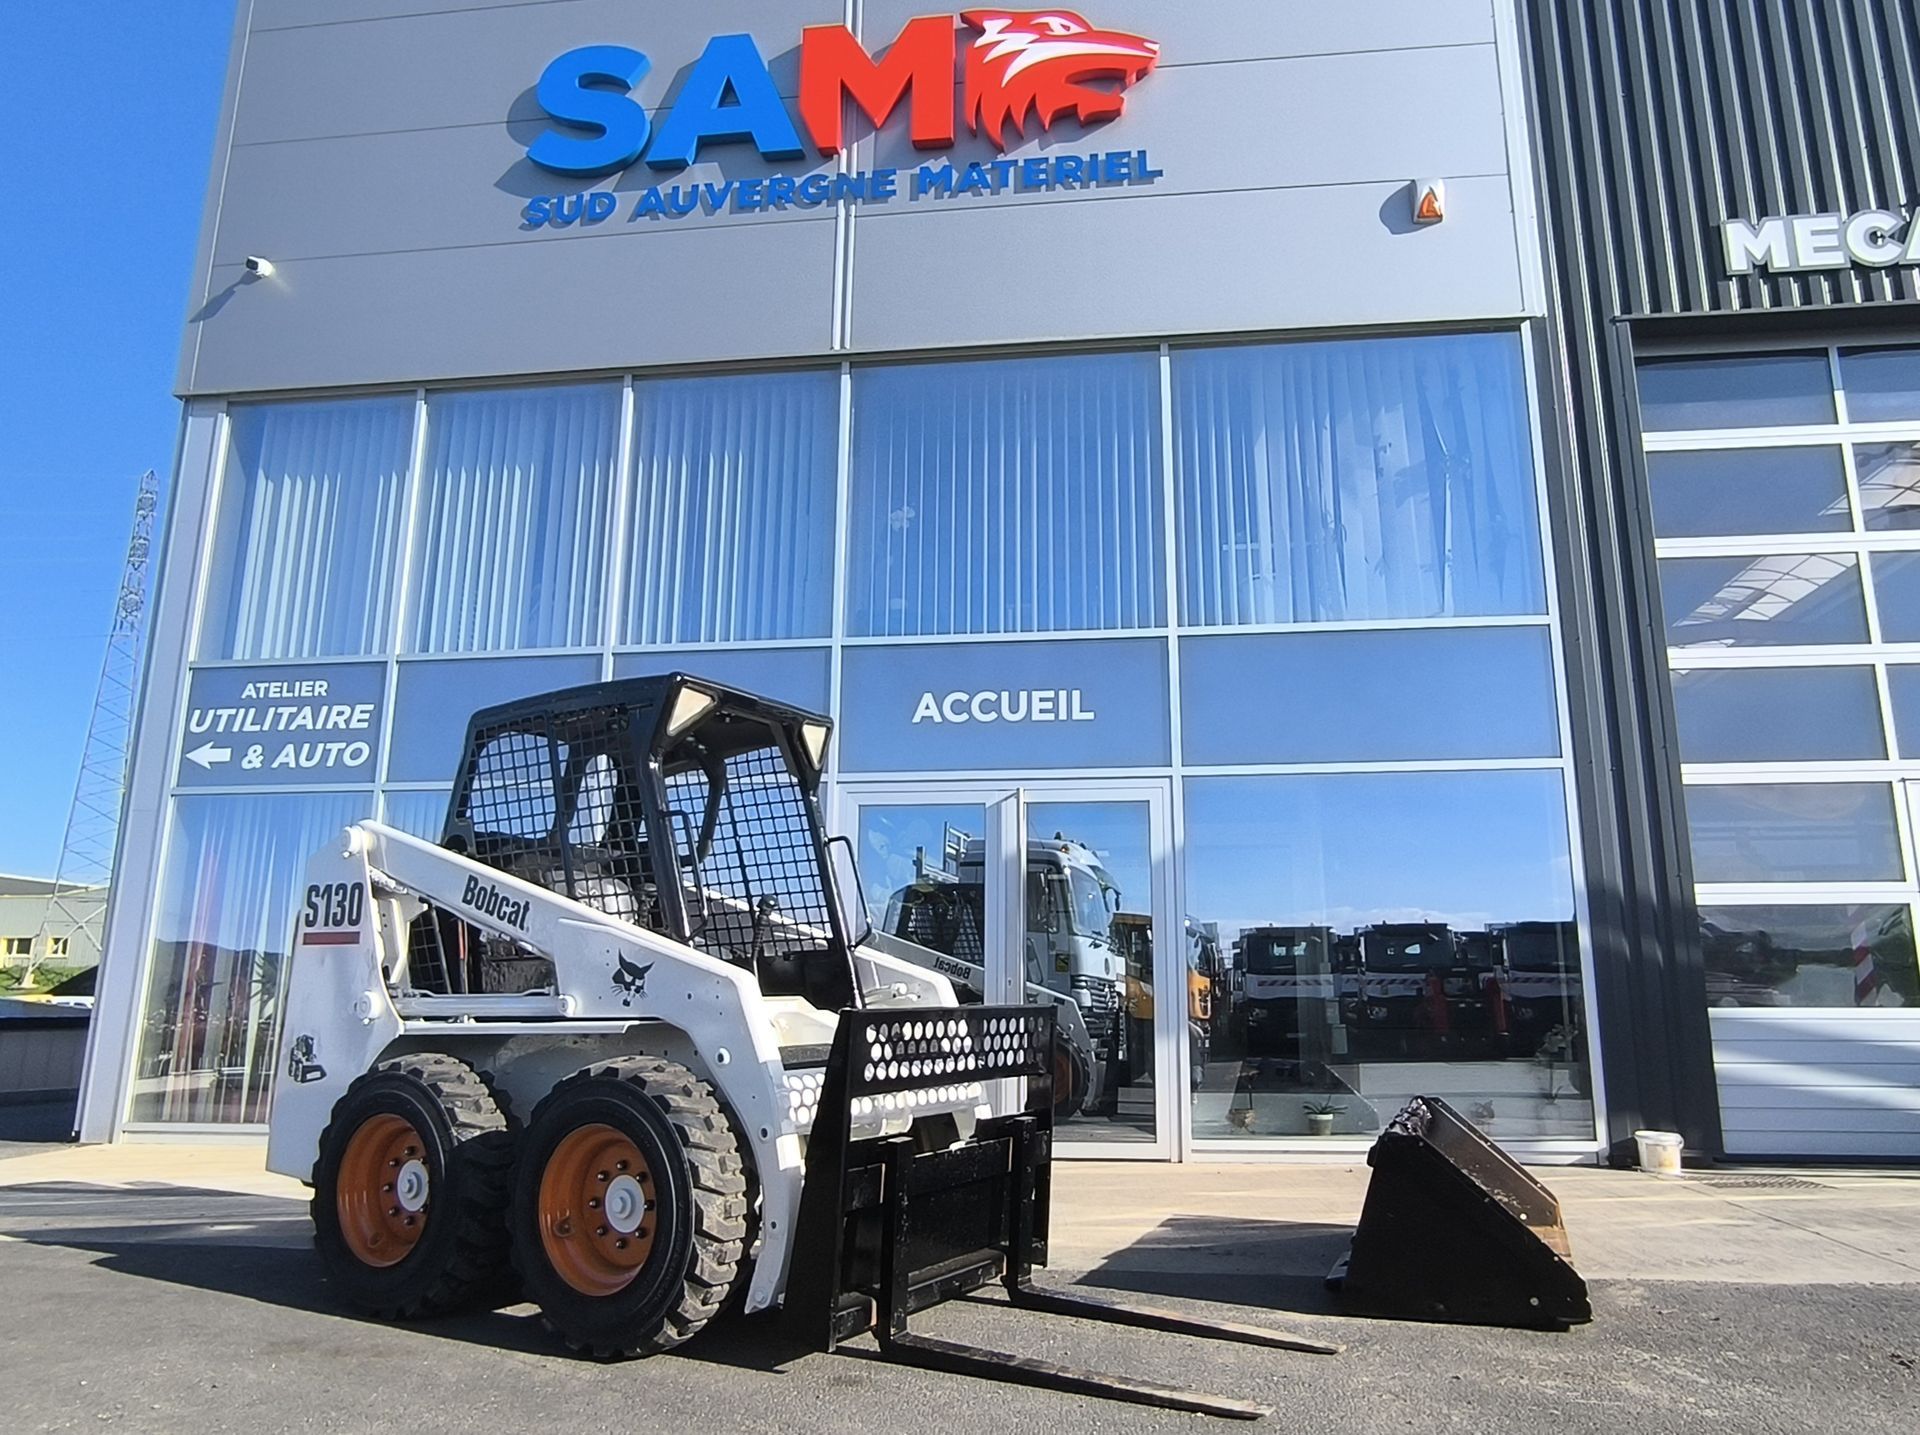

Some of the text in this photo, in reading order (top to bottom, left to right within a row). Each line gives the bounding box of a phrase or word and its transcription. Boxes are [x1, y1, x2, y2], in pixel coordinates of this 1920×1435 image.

[526, 15, 956, 178] SAM
[525, 150, 1164, 227] SUD AUVERGNE MATERIEL
[241, 680, 328, 699] ATELIER
[911, 689, 1095, 724] ACCUEIL
[189, 703, 375, 734] UTILITAIRE
[241, 741, 370, 770] & AUTO
[304, 881, 364, 928] S130
[461, 873, 530, 932] Bobcat
